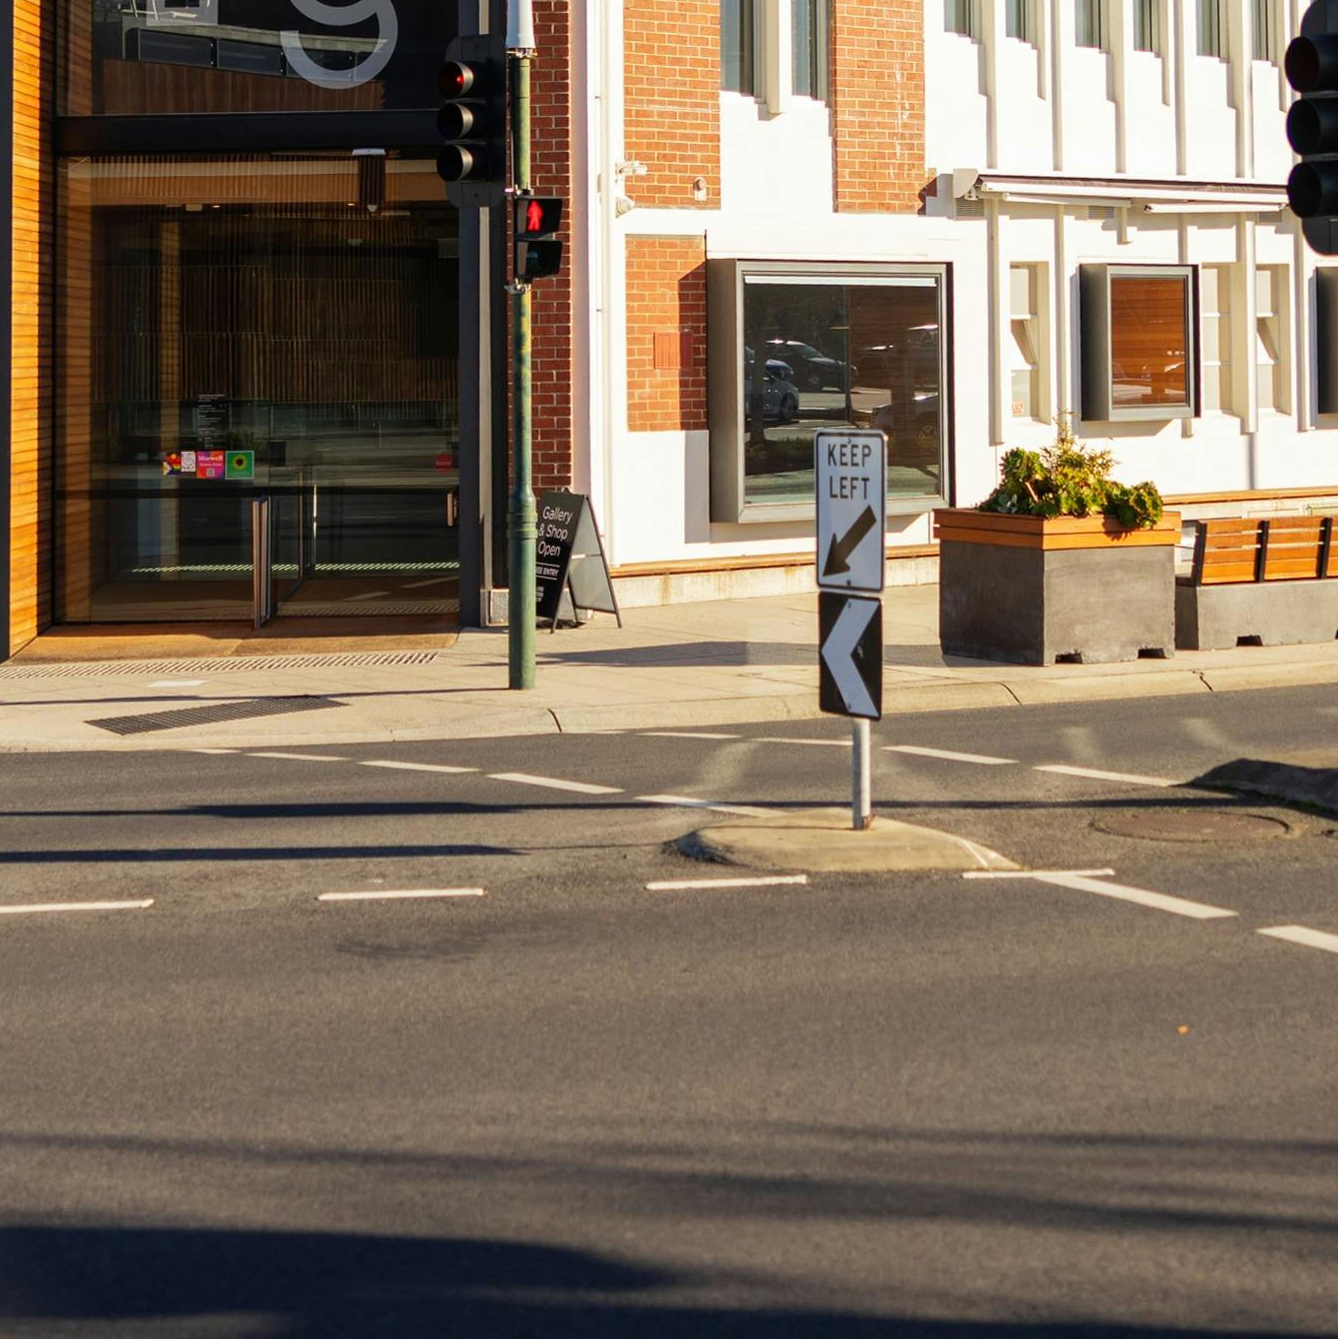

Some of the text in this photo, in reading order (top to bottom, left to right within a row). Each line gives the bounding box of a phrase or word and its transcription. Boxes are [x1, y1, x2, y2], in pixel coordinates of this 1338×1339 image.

[828, 444, 872, 467] KEEP
[829, 476, 870, 500] LEFT
[543, 506, 573, 525] Gallery
[538, 524, 568, 541] & Shop
[538, 541, 561, 558] Open
[543, 567, 559, 577] ENTRY
